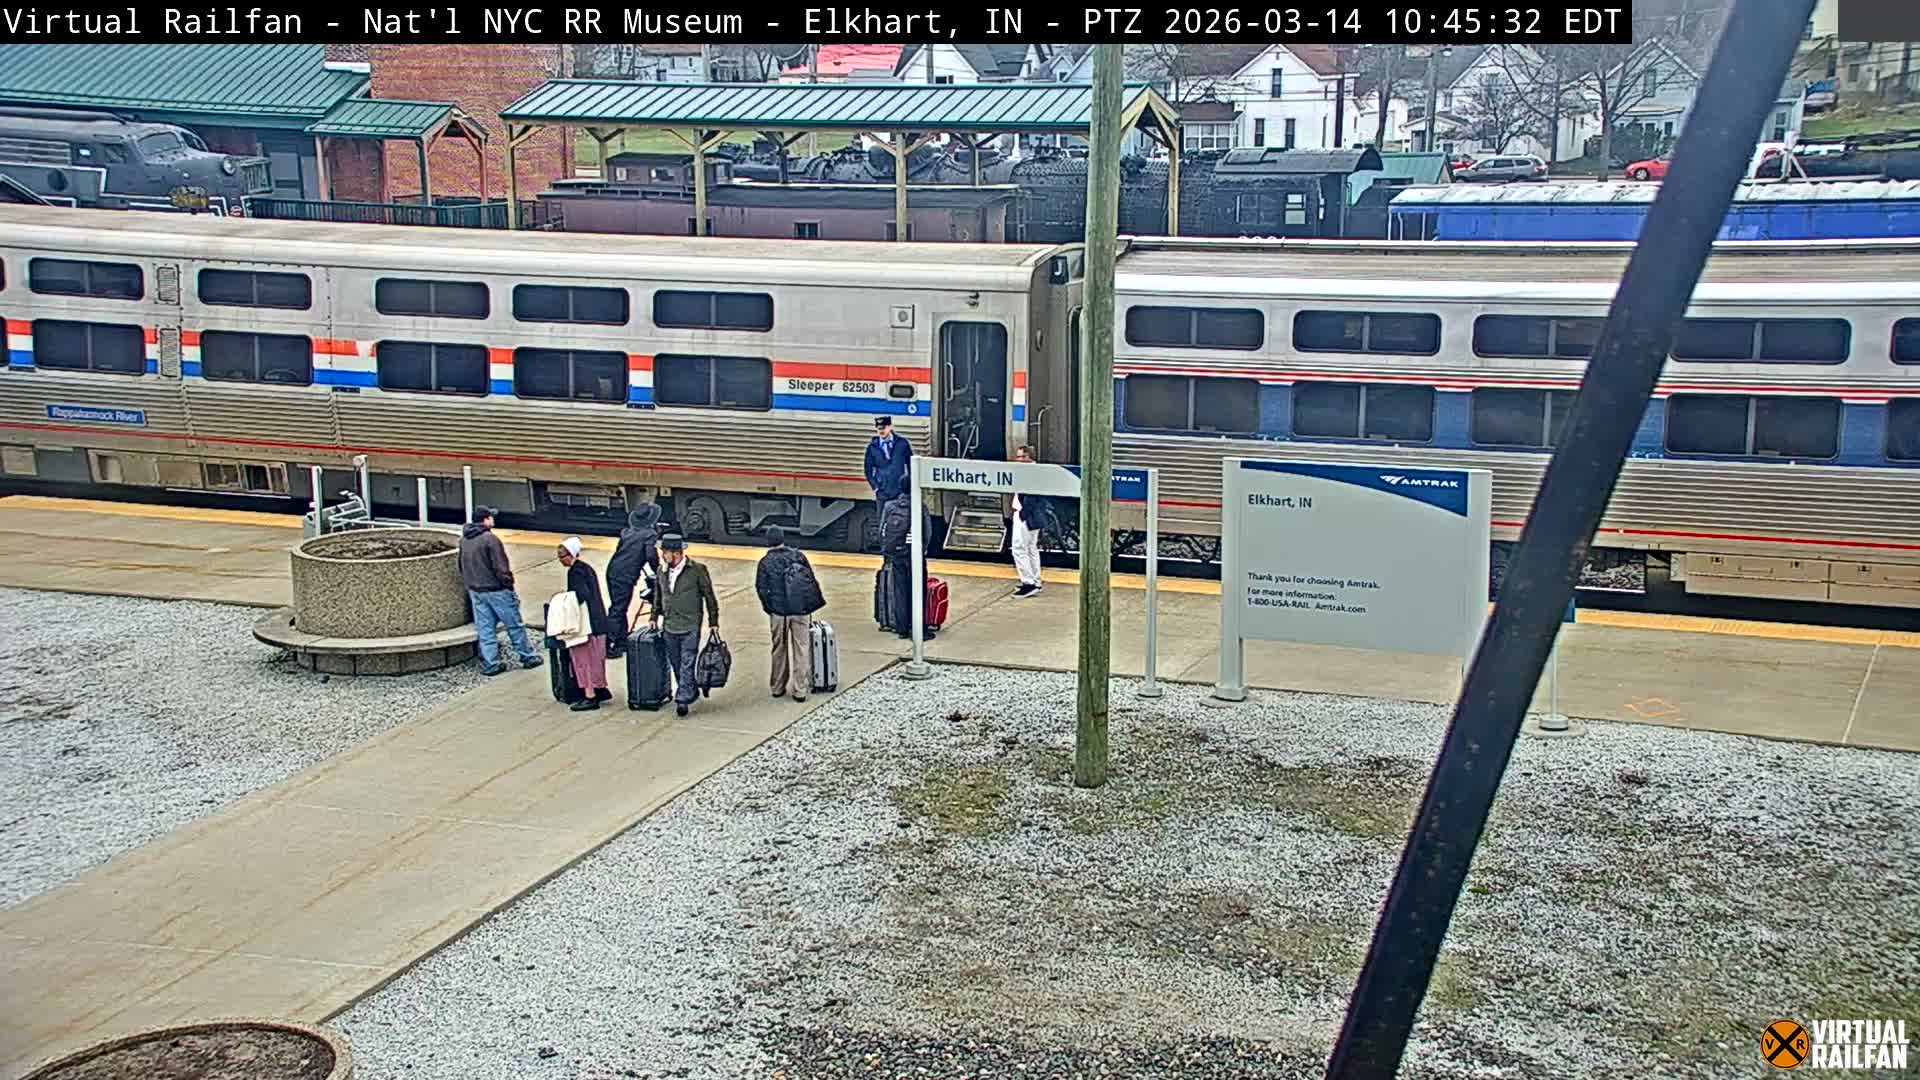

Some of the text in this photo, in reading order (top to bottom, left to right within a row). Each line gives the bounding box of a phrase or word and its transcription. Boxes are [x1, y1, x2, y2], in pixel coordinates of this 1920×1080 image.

[788, 379, 876, 393] Sleeper 62503
[932, 467, 1013, 486] Elkhart, IN
[1400, 478, 1459, 488] AMTRAK
[1248, 494, 1312, 508] Elkhart, IN
[1248, 572, 1380, 589] Thank you for choosing Amtrak.
[1248, 587, 1260, 595] For
[1315, 602, 1366, 613] Amtrak.com
